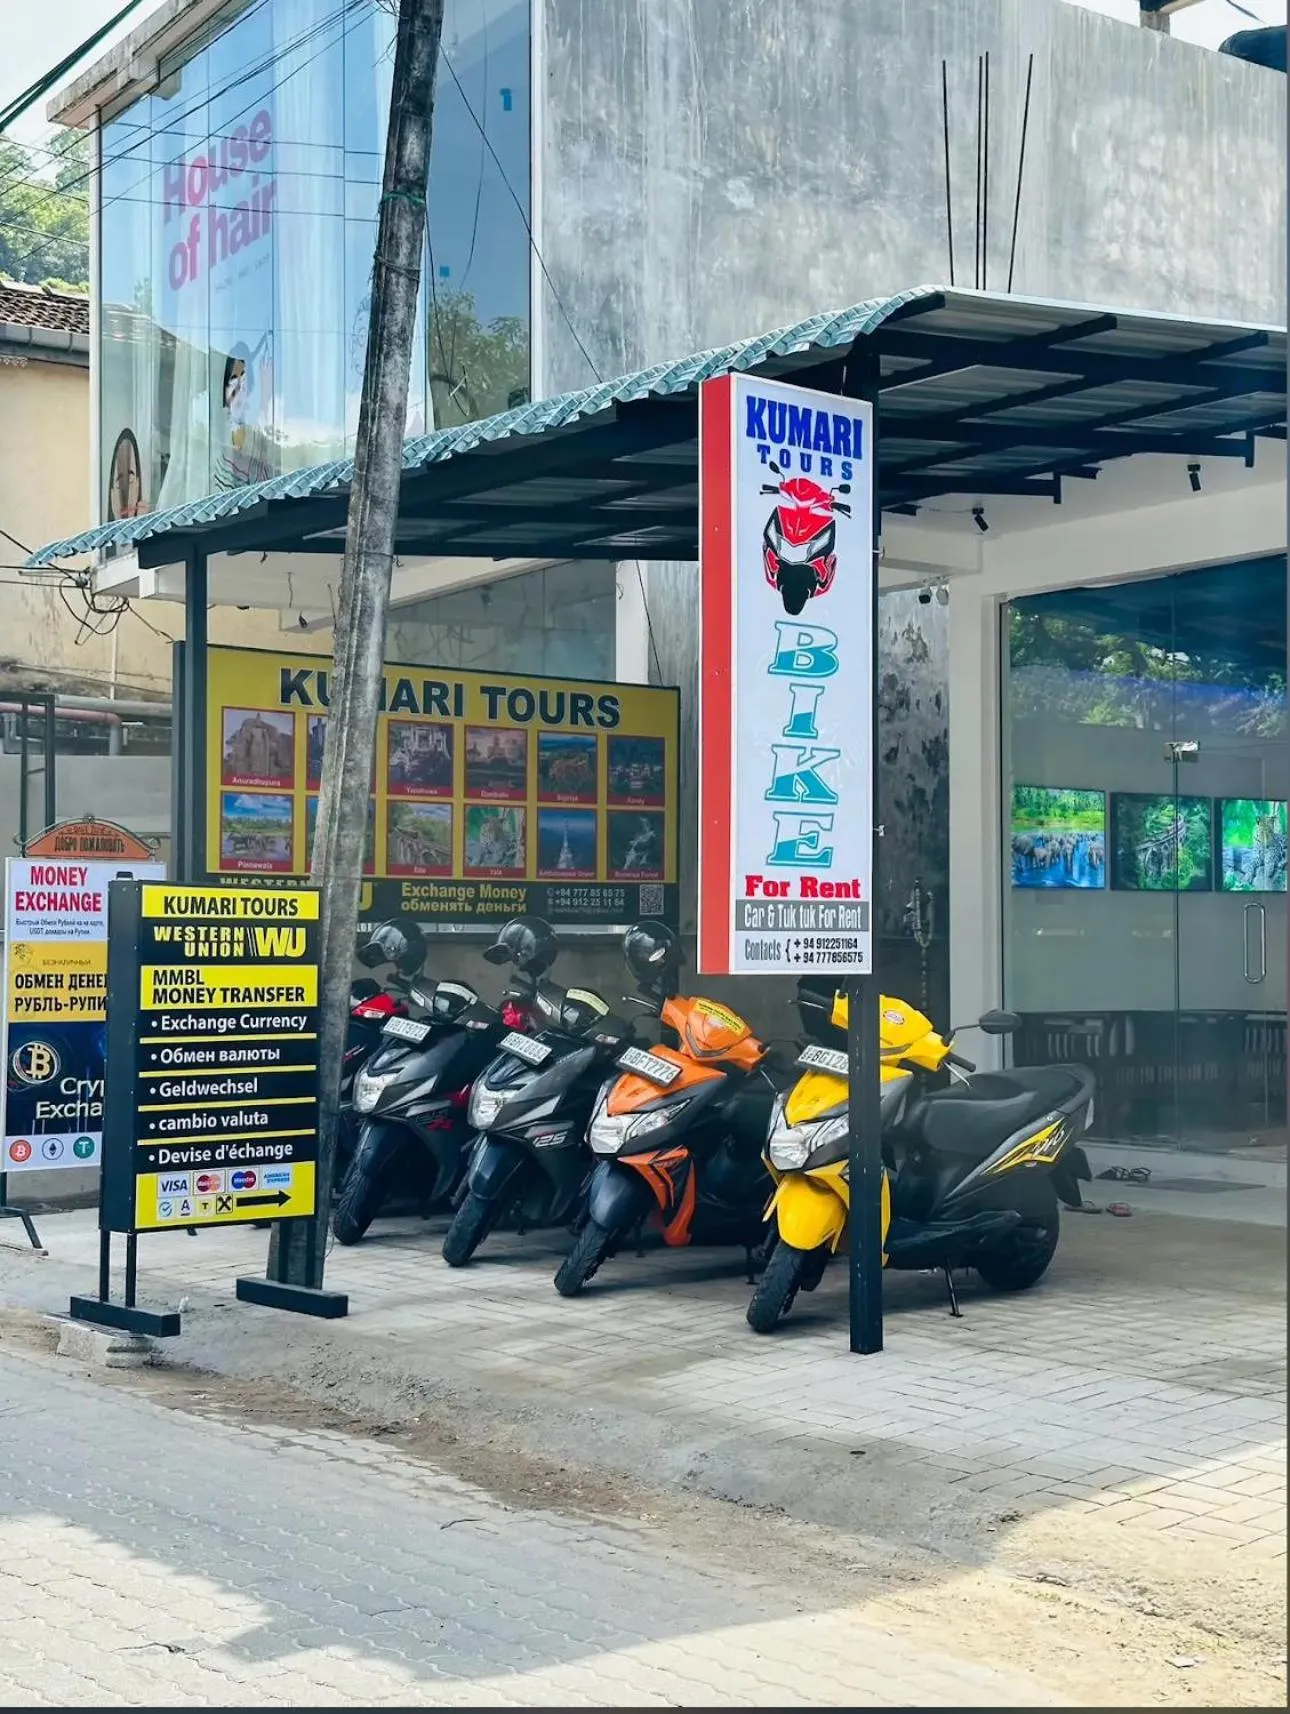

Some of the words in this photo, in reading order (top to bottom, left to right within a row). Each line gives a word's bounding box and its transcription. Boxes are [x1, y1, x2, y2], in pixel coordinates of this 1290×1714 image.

[163, 110, 271, 226] House
[168, 213, 201, 291] of
[208, 172, 277, 268] hair
[746, 395, 863, 460] KUMARI
[757, 443, 853, 480] TOURS
[280, 667, 464, 717] KUARI
[479, 685, 621, 728] TOURS
[764, 620, 841, 868] BIKE
[30, 866, 88, 886] MONEY
[401, 882, 475, 900] Exchange
[479, 884, 527, 901] Money
[745, 875, 791, 897] For
[799, 876, 861, 898] Rent
[15, 892, 102, 912] EXCHANGE
[163, 895, 237, 914] KUMARI
[240, 897, 298, 916] TOURS
[401, 898, 472, 911] обменять
[475, 902, 527, 913] деньги
[744, 904, 765, 928] Car
[767, 904, 775, 928] &
[778, 904, 796, 929] Tuk
[799, 905, 816, 929] tuk
[818, 905, 836, 929] For
[838, 905, 861, 929] Rent
[153, 926, 244, 941] WESTERN
[254, 927, 306, 958] WU
[803, 938, 814, 949] 94
[816, 938, 858, 949] 912251164
[184, 942, 244, 957] UNION
[744, 938, 781, 960] Contacts
[803, 952, 814, 963] 94
[15, 973, 64, 989] ОБМЕН
[68, 973, 107, 991] ДЕНЕ
[153, 969, 204, 985] MMBL
[153, 987, 217, 1004] MONEY
[220, 987, 305, 1003] TRANSFER
[161, 1014, 236, 1033] Exchange
[240, 1014, 307, 1031] Currency
[160, 1048, 215, 1064] Обмен
[219, 1048, 280, 1062] валюты
[60, 1077, 104, 1097] Cry
[159, 1077, 258, 1097] Geldwechsel
[158, 1113, 217, 1131] cambio
[221, 1111, 268, 1126] valuta
[158, 1147, 212, 1164] Devise
[215, 1143, 293, 1160] d'échange
[161, 1179, 188, 1192] VISA
